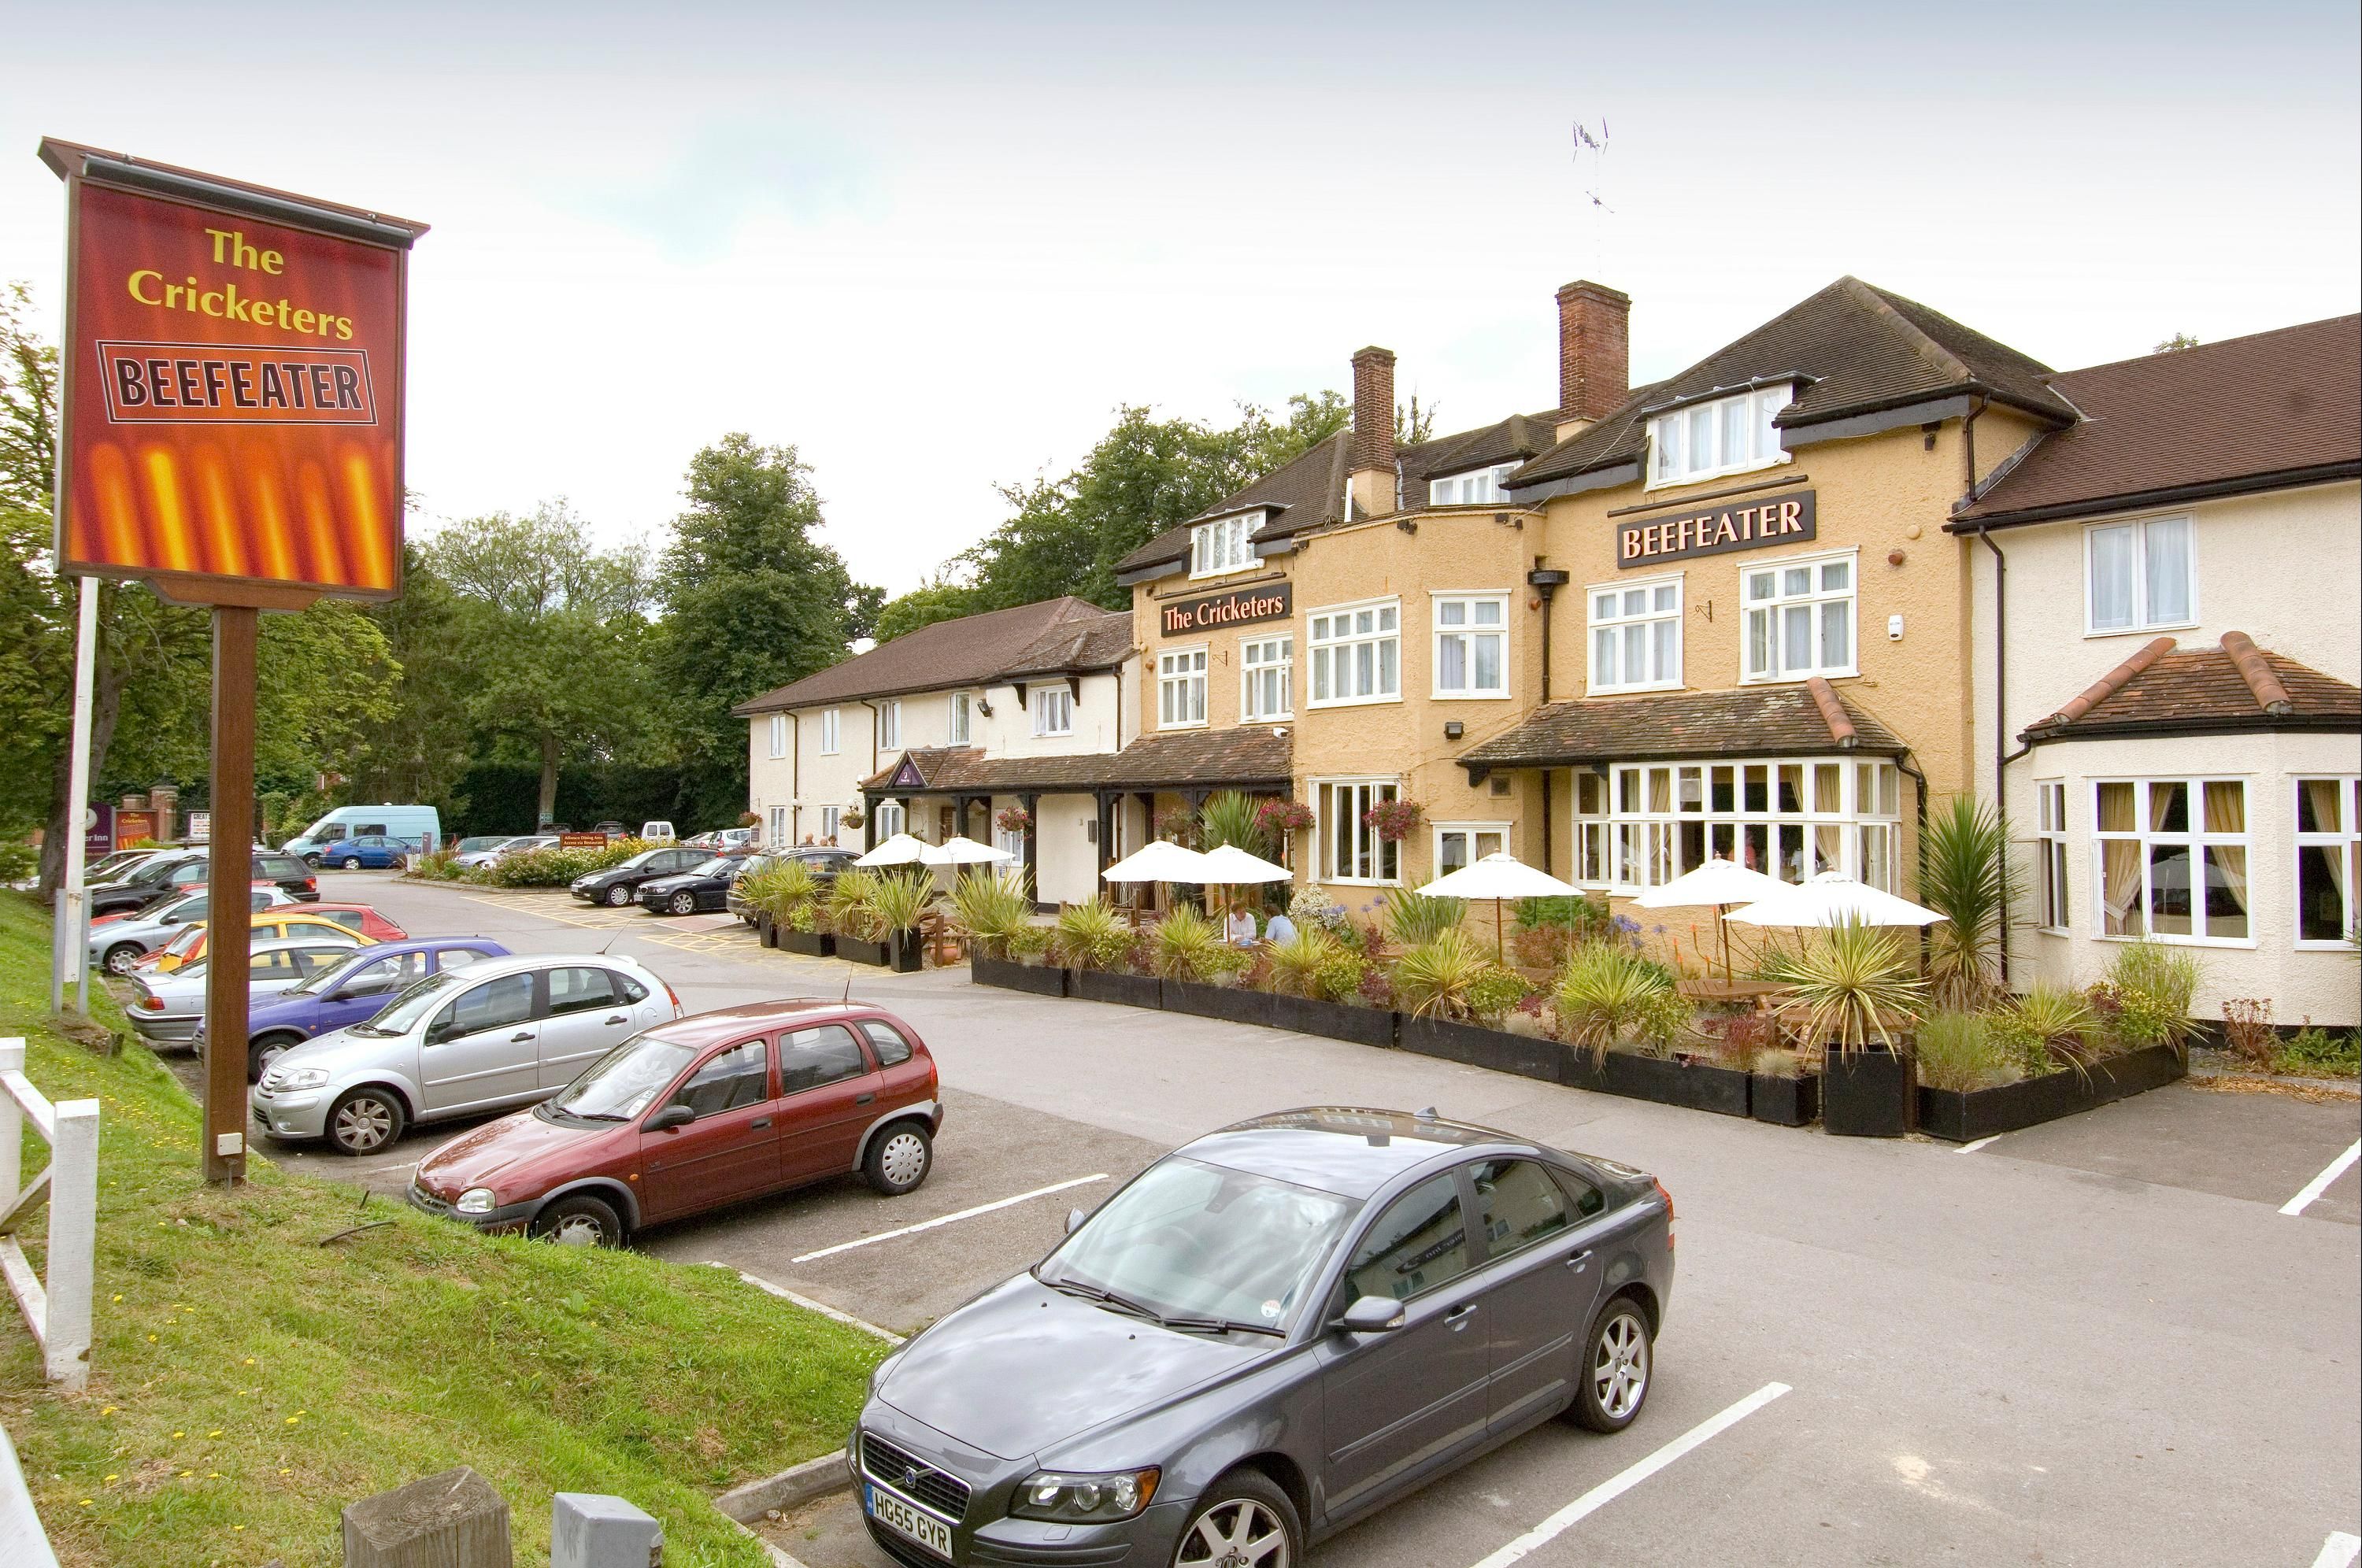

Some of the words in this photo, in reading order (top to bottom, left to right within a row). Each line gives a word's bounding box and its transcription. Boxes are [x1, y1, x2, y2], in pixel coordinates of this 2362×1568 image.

[205, 228, 283, 275] The
[128, 270, 354, 341] Cricketers
[114, 357, 364, 410] BEEFEATER
[1623, 501, 1804, 560] BEEFEATER
[1164, 607, 1192, 631] The
[1197, 596, 1284, 626] Cricketers
[875, 1492, 913, 1533] HG55
[917, 1516, 947, 1552] GYR
